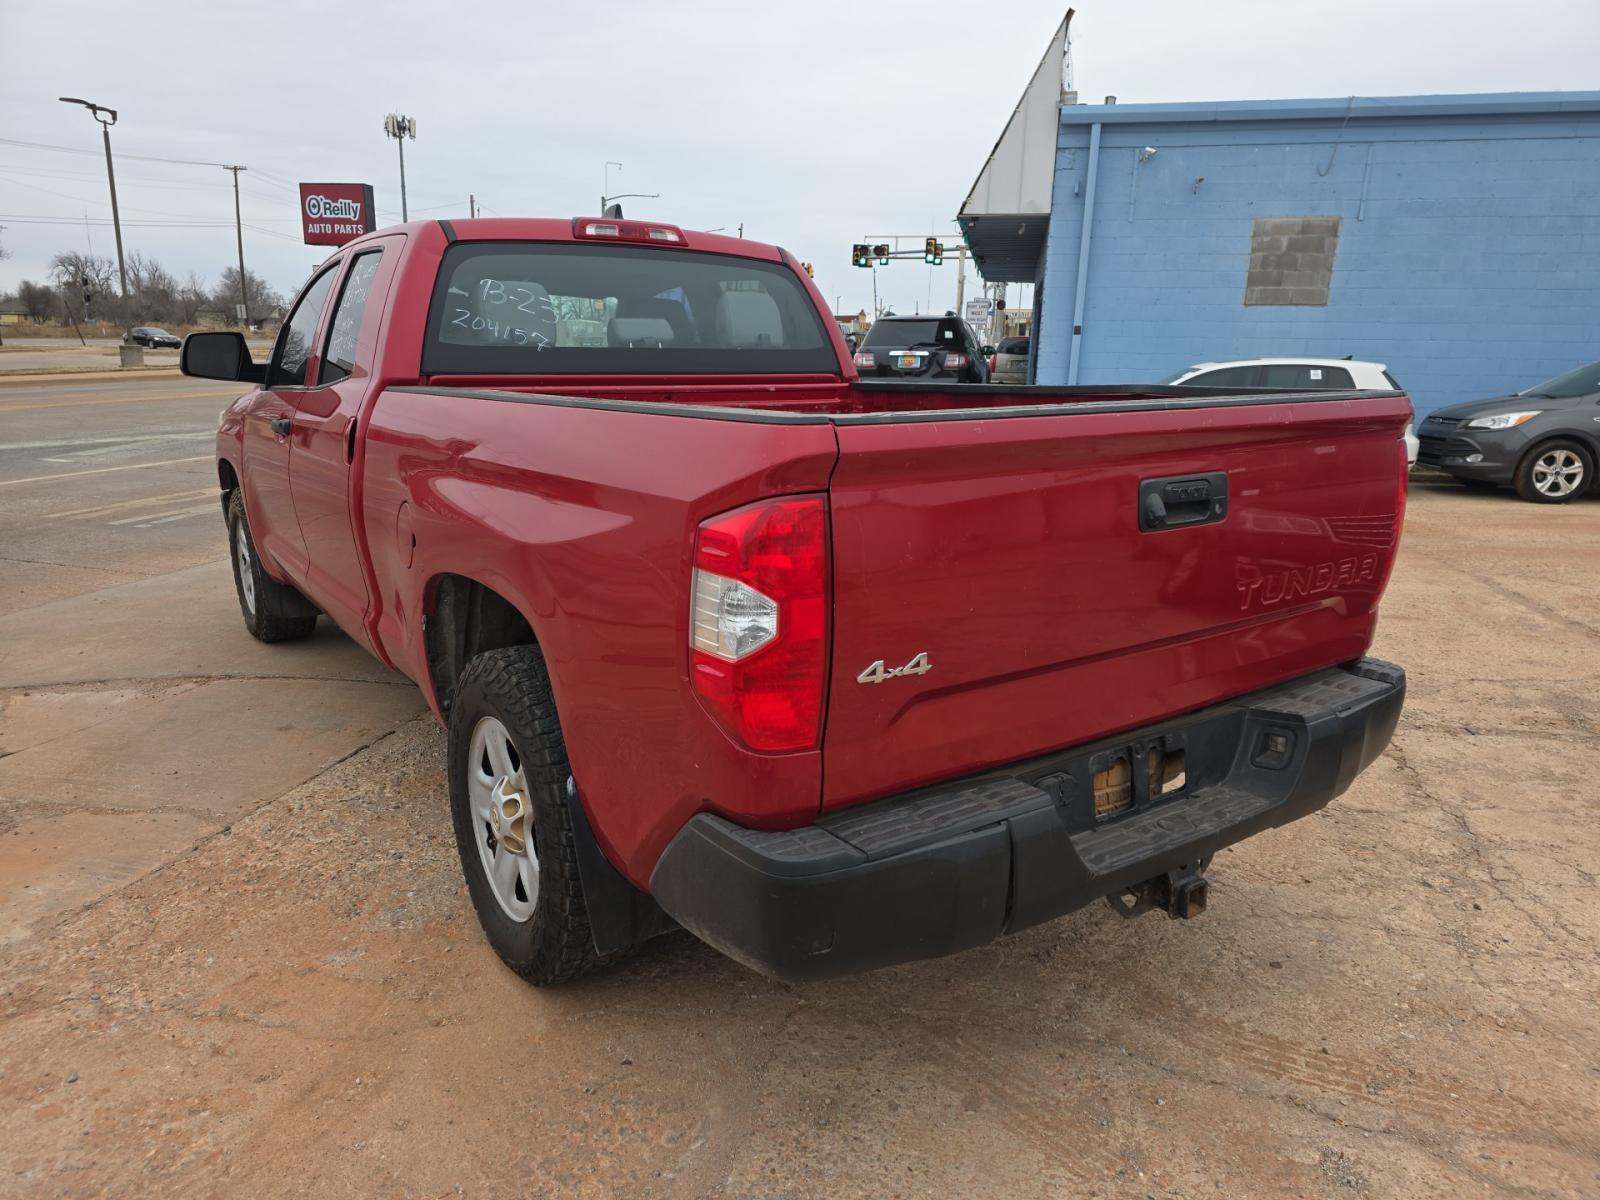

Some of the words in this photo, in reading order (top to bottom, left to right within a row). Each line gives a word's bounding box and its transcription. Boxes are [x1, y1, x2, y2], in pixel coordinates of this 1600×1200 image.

[306, 195, 360, 220] O'Reilly
[308, 223, 332, 234] AUTO
[334, 224, 364, 235] PARTS
[1234, 553, 1378, 611] TUNDRA
[857, 652, 933, 684] 4x4
